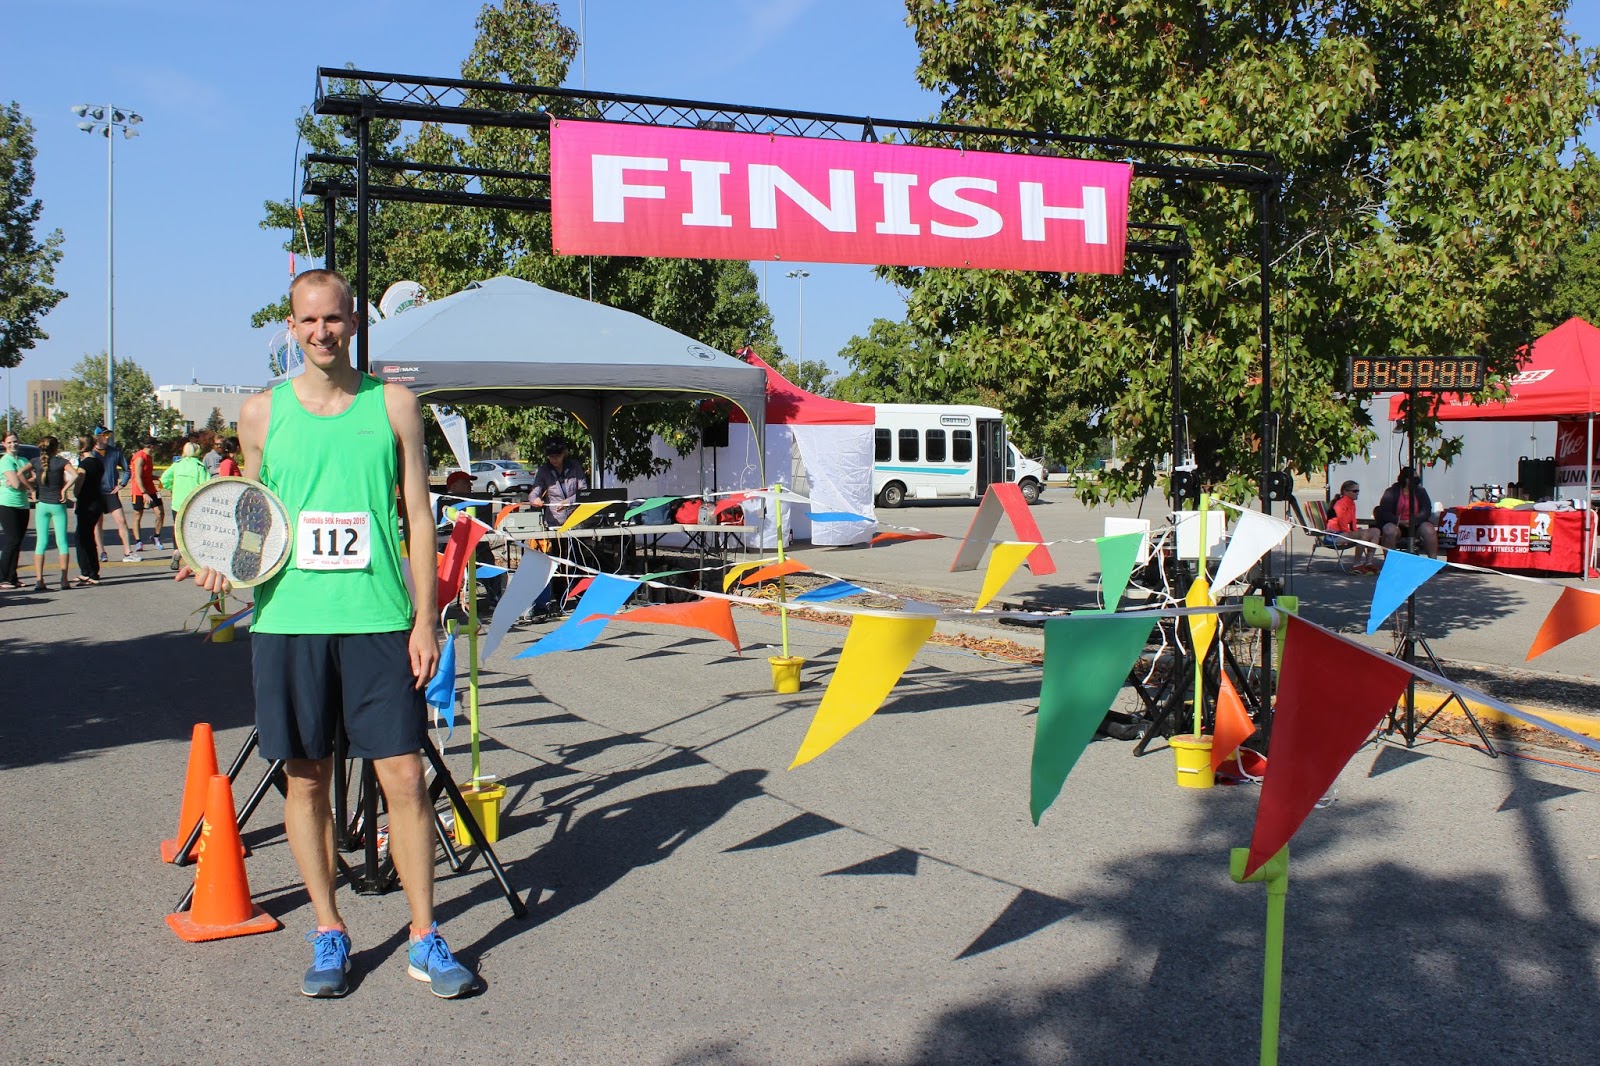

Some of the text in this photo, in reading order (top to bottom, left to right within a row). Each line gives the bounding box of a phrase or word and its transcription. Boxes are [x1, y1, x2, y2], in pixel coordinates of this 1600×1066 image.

[591, 154, 1108, 245] FINISH
[303, 517, 323, 525] Foothills
[336, 518, 352, 526] Frenzy
[214, 526, 236, 536] PLACE
[1476, 528, 1529, 543] PULSE
[312, 528, 358, 556] 112
[1459, 545, 1486, 553] RUNNING
